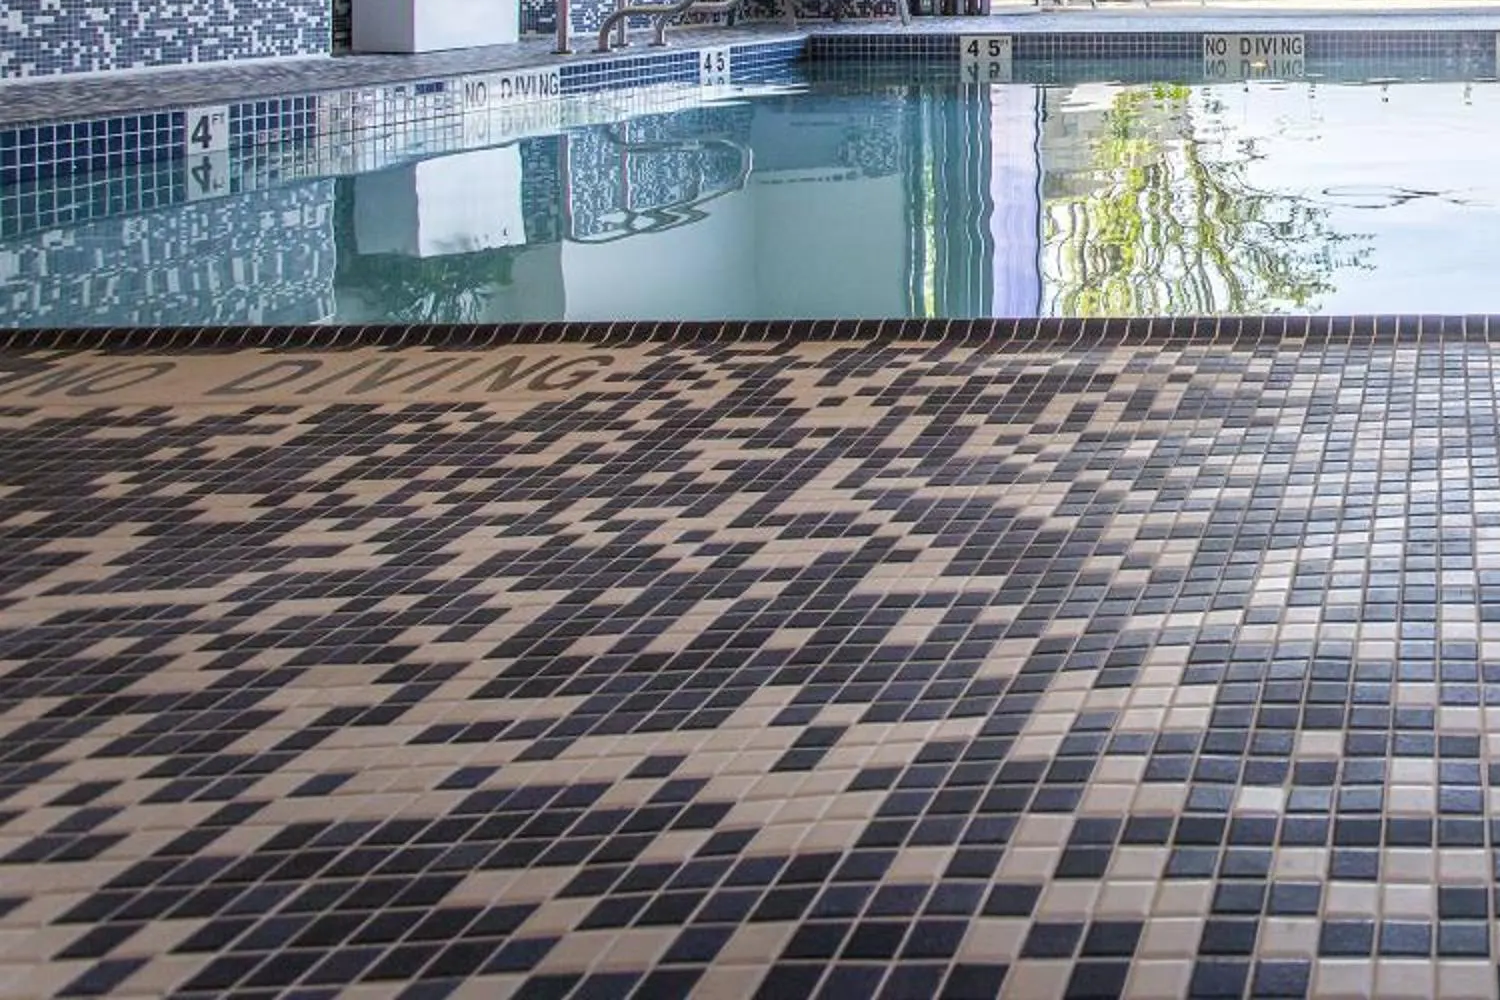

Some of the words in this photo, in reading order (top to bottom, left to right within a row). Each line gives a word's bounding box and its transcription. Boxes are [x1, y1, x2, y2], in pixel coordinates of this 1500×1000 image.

[1206, 37, 1227, 56] NO
[1240, 37, 1302, 56] DIVING
[465, 81, 487, 108] NO
[501, 73, 559, 99] DIVING
[191, 115, 212, 149] 4
[0, 361, 177, 397] NO
[203, 355, 615, 396] DIVING
